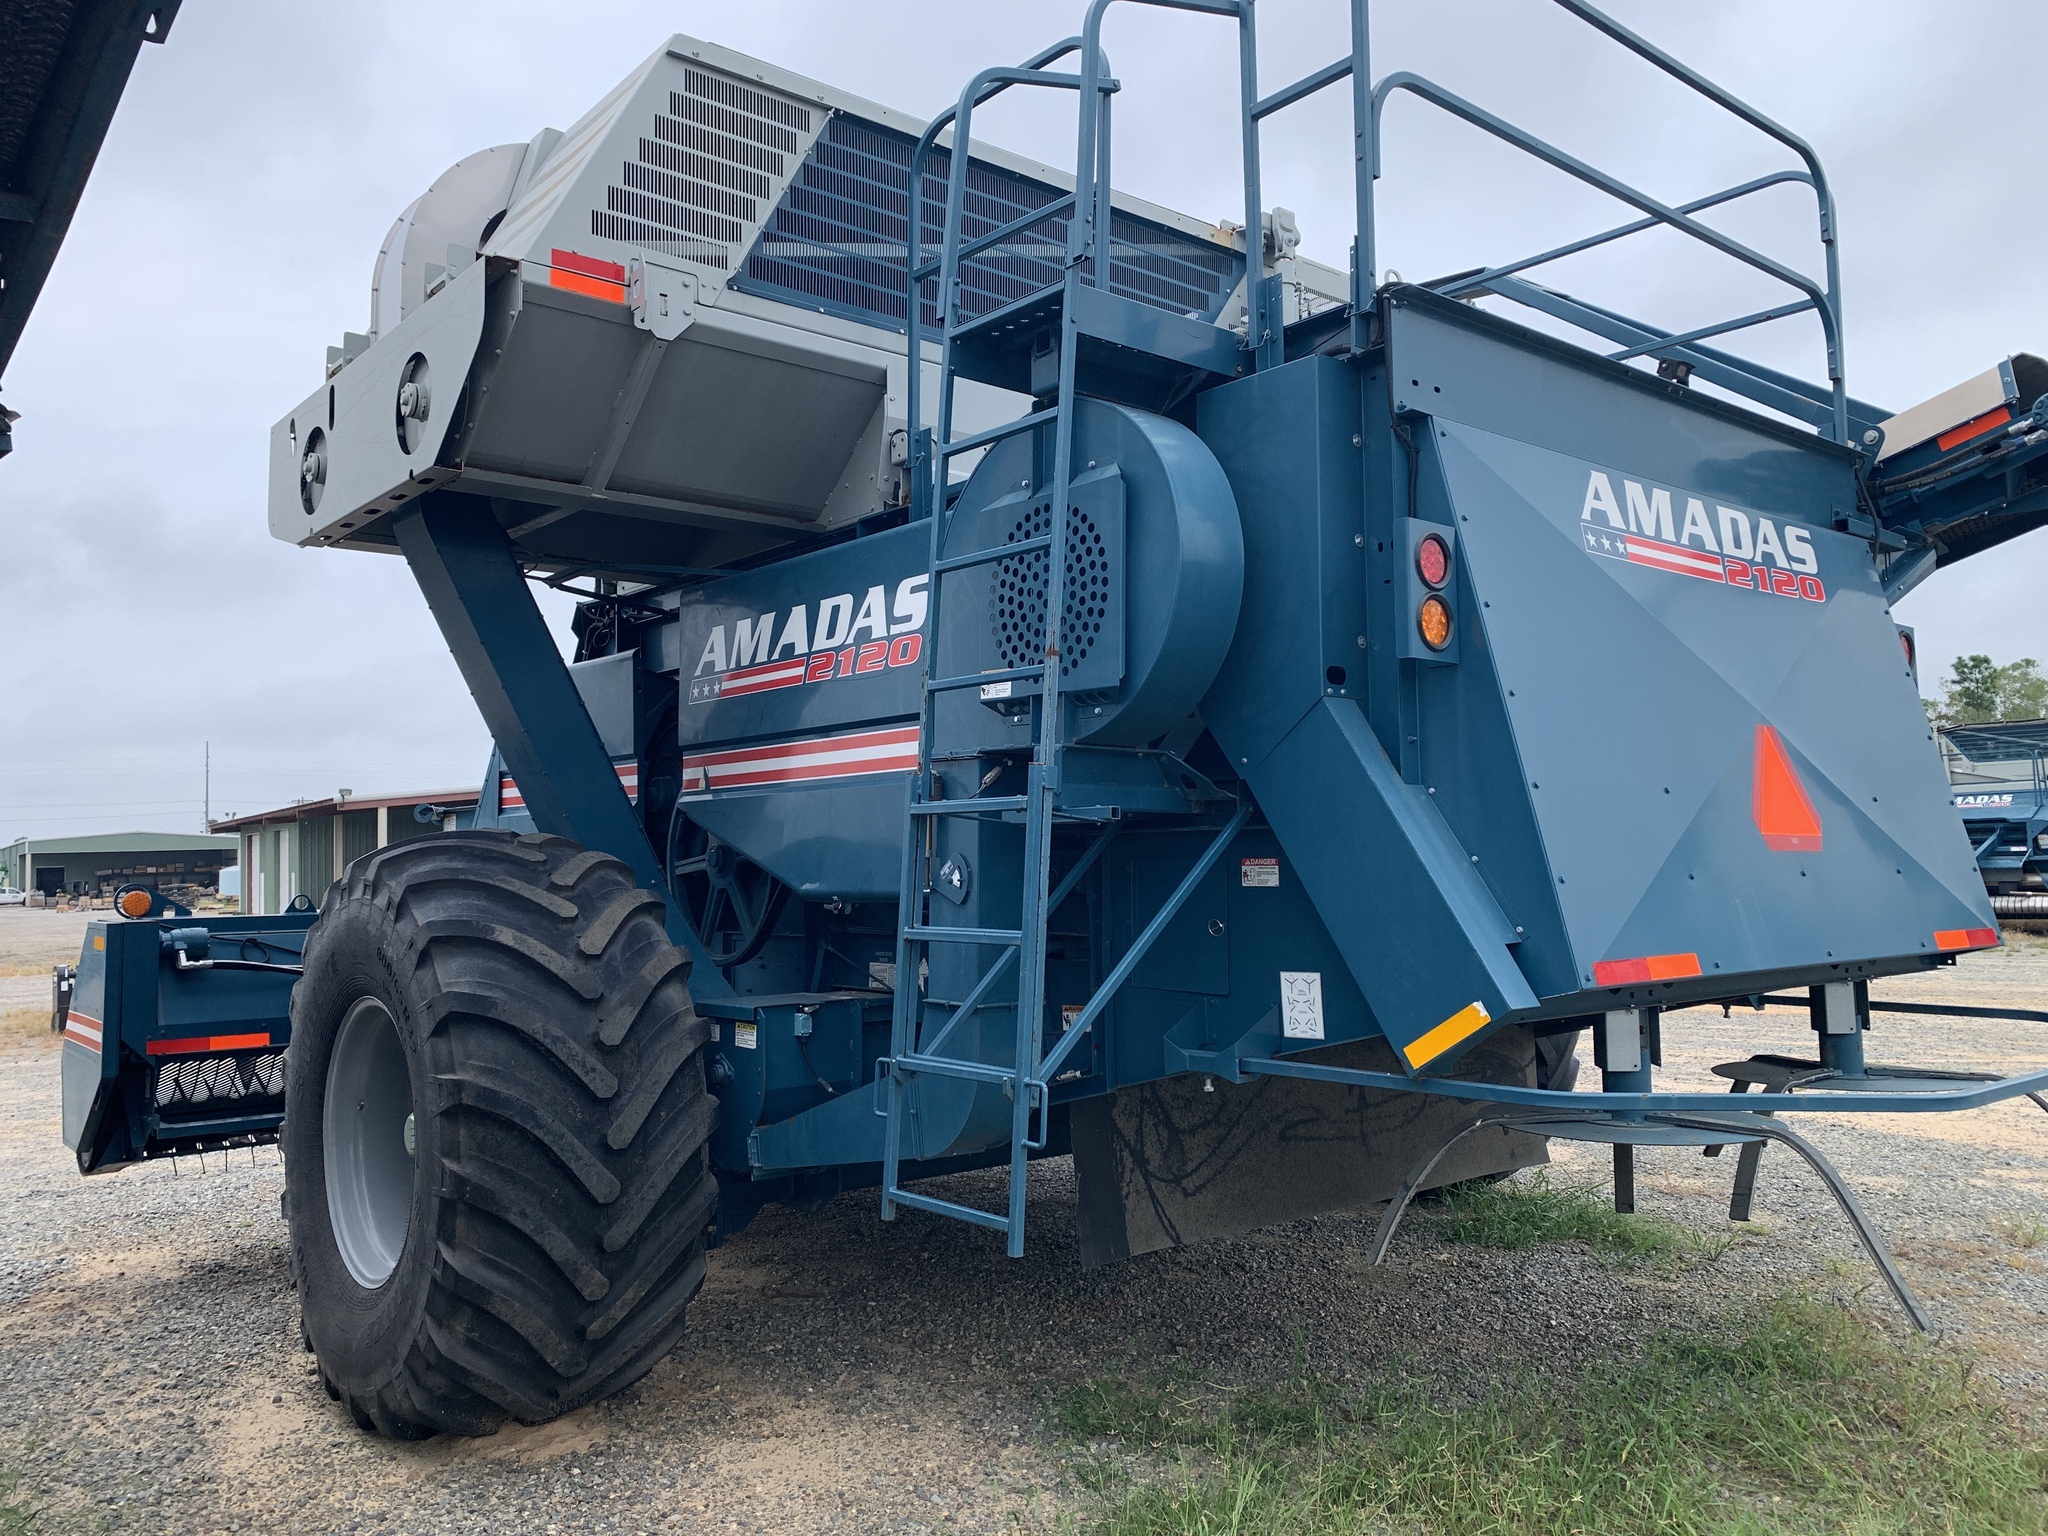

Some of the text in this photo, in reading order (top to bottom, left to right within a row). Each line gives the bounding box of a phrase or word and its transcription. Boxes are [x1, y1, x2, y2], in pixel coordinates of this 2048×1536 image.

[1581, 470, 1818, 574] AMADAS
[1724, 557, 1826, 602] 2120
[694, 573, 929, 677] AMADAS
[805, 633, 923, 683] 2120
